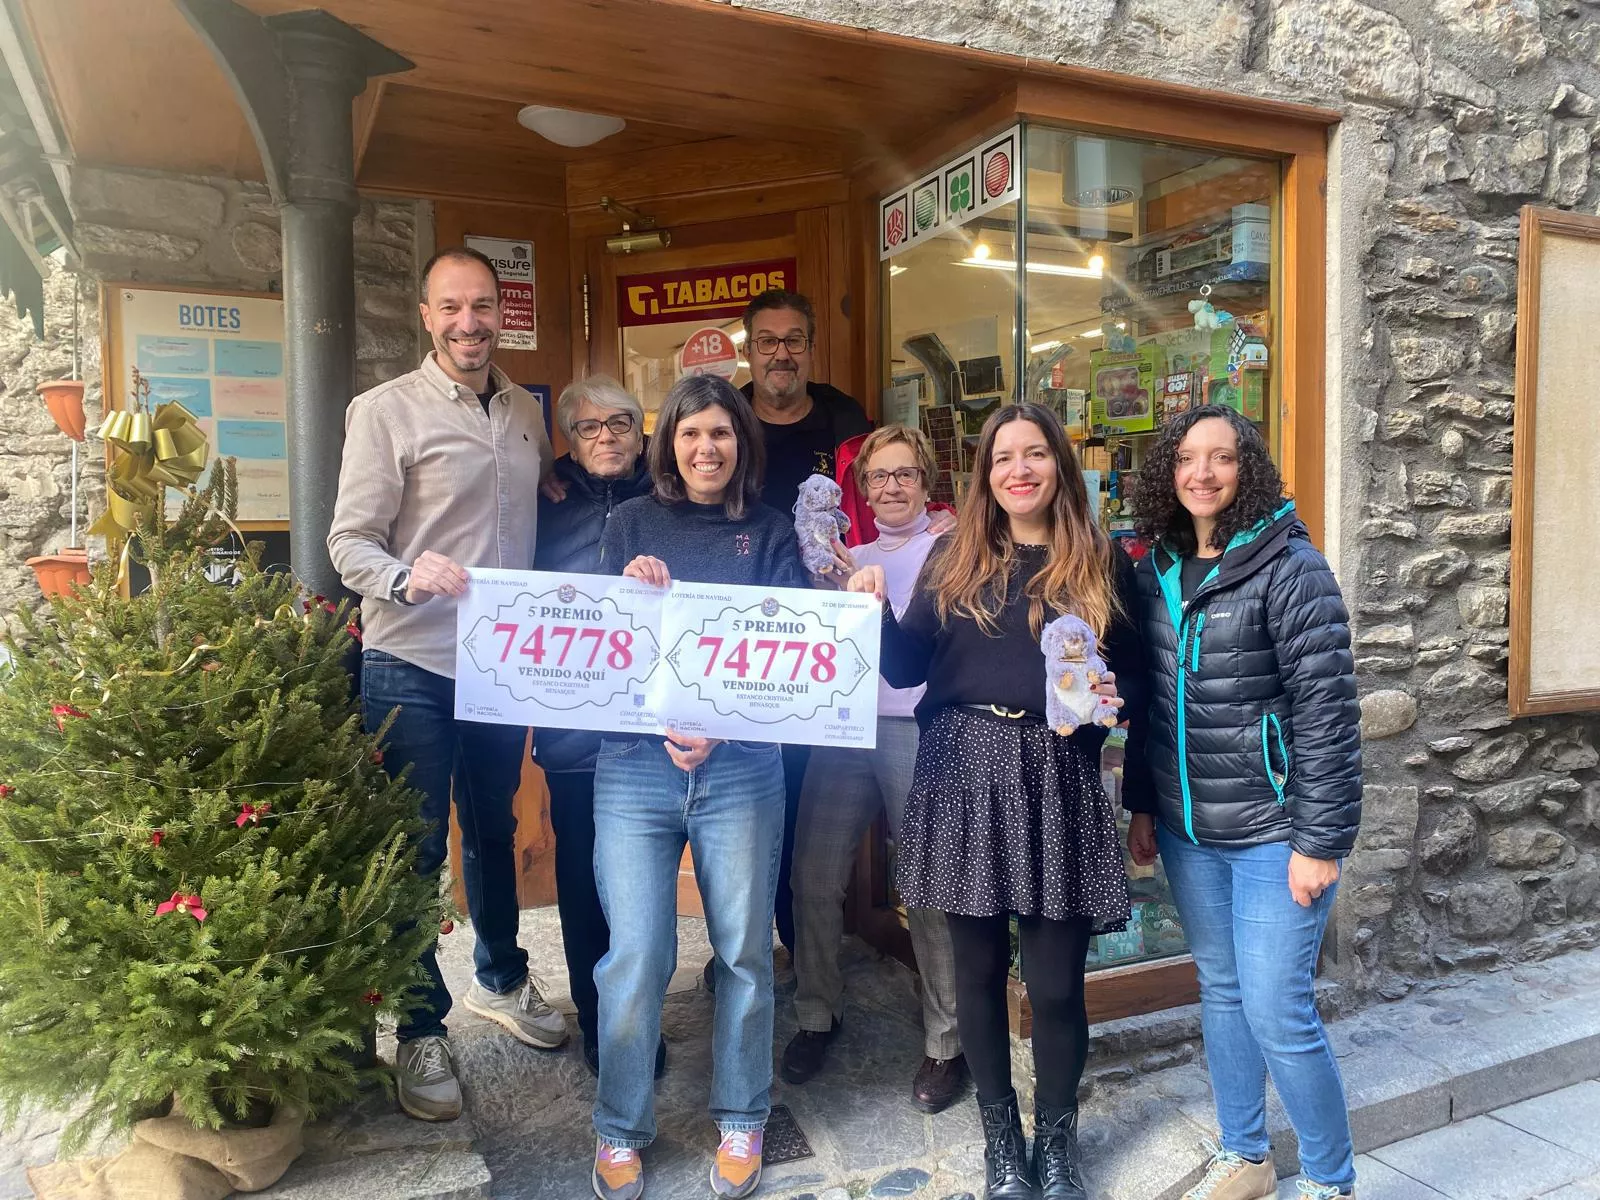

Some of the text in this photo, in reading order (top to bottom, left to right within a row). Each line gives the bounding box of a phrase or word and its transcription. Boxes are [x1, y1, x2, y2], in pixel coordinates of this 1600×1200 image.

[489, 258, 531, 270] risure
[500, 288, 532, 299] rma
[663, 270, 785, 306] TABACOS
[504, 307, 532, 316] ágenes
[506, 300, 532, 308] abación
[178, 303, 241, 329] BOTES
[691, 334, 723, 356] +18
[671, 592, 696, 600] LOTERÍA
[705, 594, 732, 602] NAVIDAD
[528, 605, 604, 622] 5 PREMIO
[732, 619, 807, 634] 5 PREMIO
[492, 622, 634, 670] 74778
[697, 636, 837, 683] 74778
[518, 666, 606, 682] VENDIDO AQUÍ
[722, 680, 809, 695] VENDIDO AQUÍ
